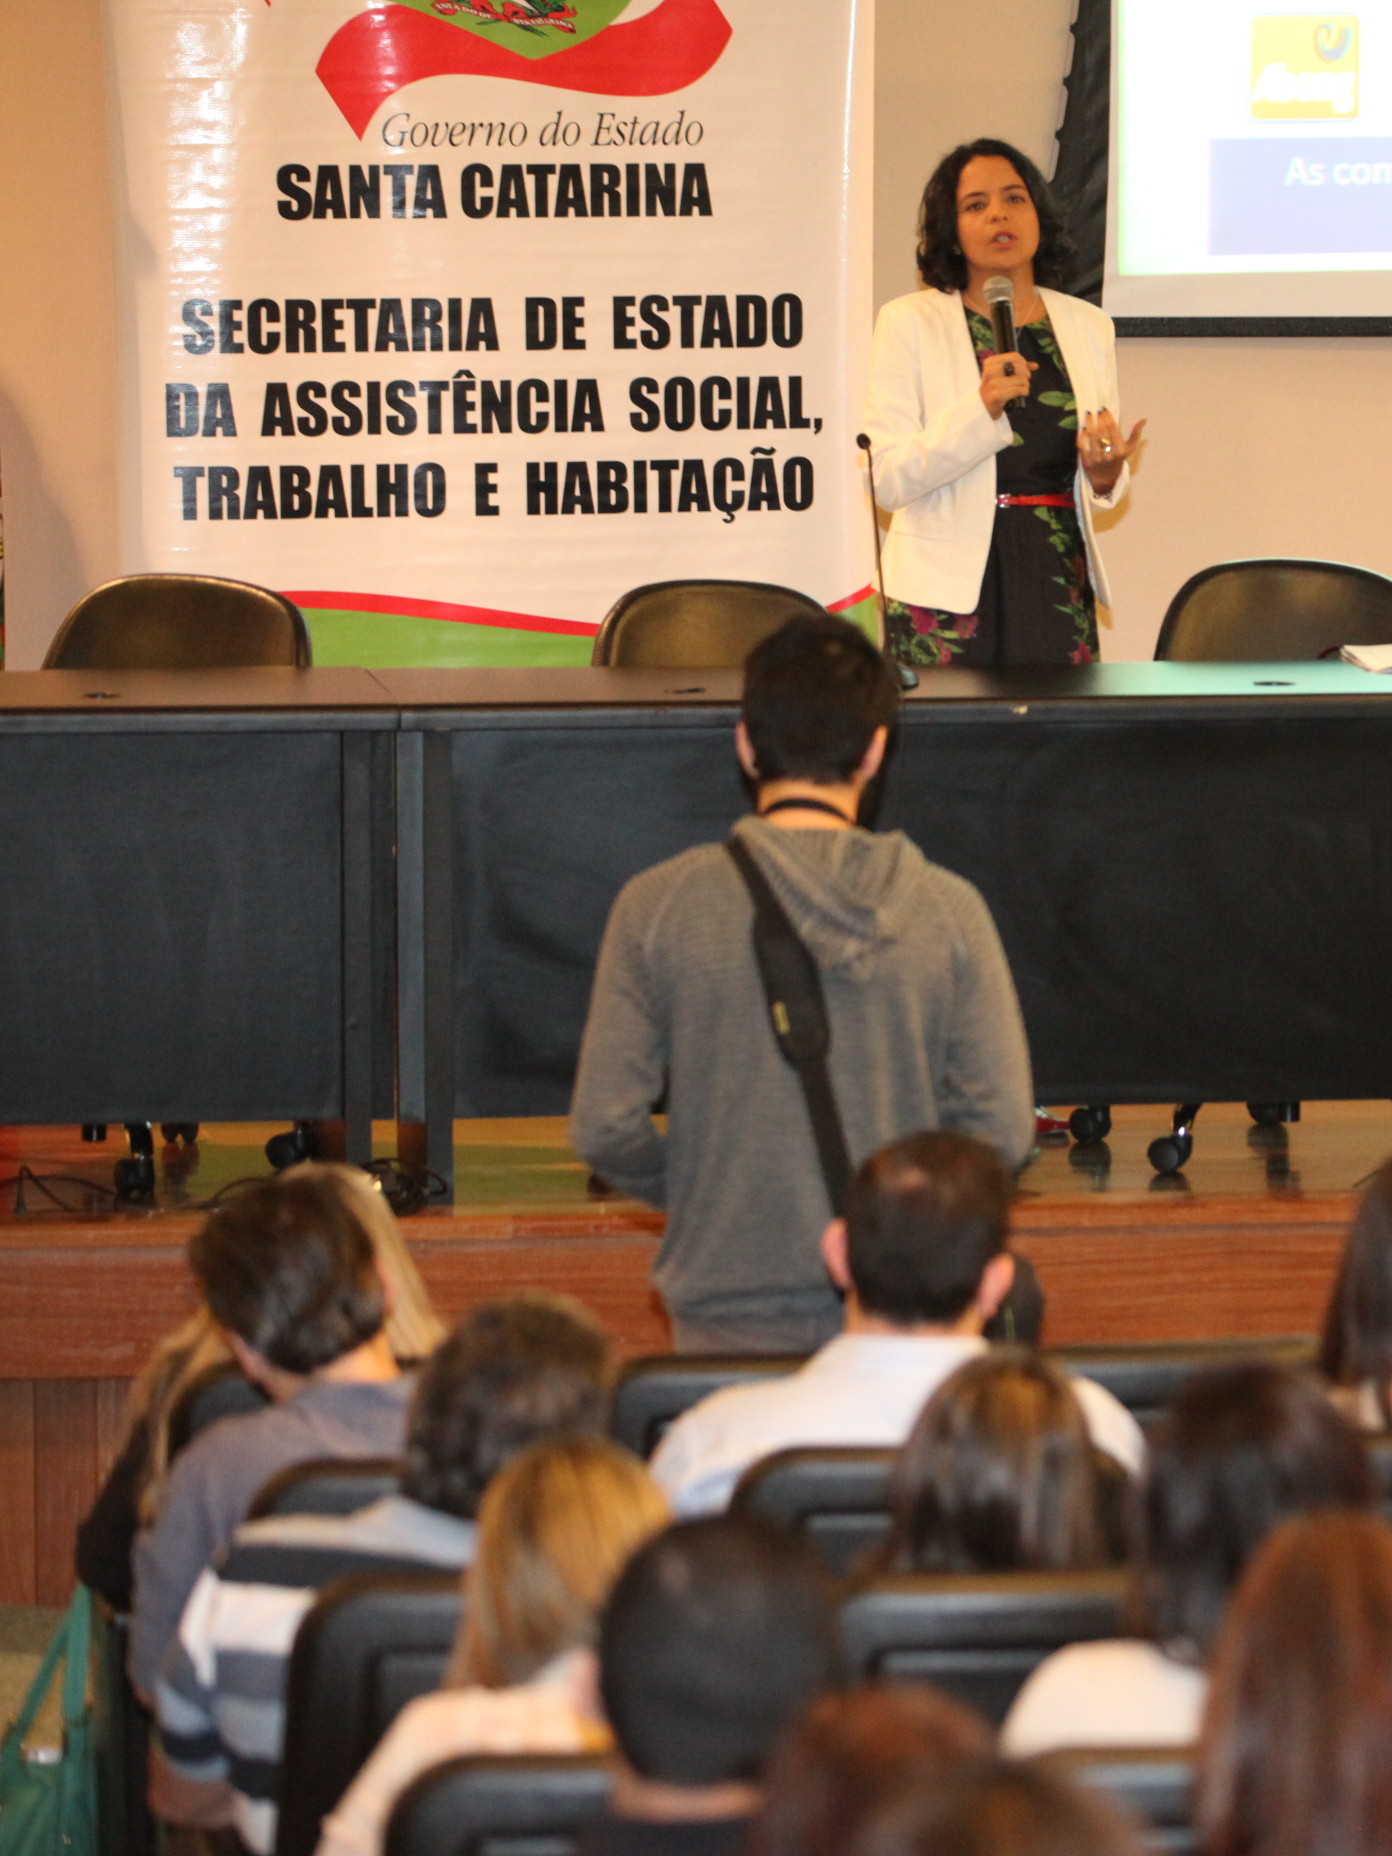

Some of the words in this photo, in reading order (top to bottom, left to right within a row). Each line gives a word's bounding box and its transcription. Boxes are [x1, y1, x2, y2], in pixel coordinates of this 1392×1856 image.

[382, 112, 527, 147] Governo
[539, 110, 581, 147] do
[592, 110, 704, 147] Estado
[276, 163, 448, 220] SANTA
[460, 163, 713, 219] CATARINA
[1284, 156, 1325, 186] As
[181, 298, 500, 355] SECRETARIA
[525, 296, 586, 351] DE
[612, 293, 803, 350] ESTADO
[165, 382, 238, 437] DA
[260, 369, 605, 437] ASSISTÊNCIA
[629, 375, 823, 435] SOCIAL,
[173, 462, 447, 521] TRABALHO
[474, 462, 500, 517] E
[526, 446, 814, 523] HABITAÇÃO
